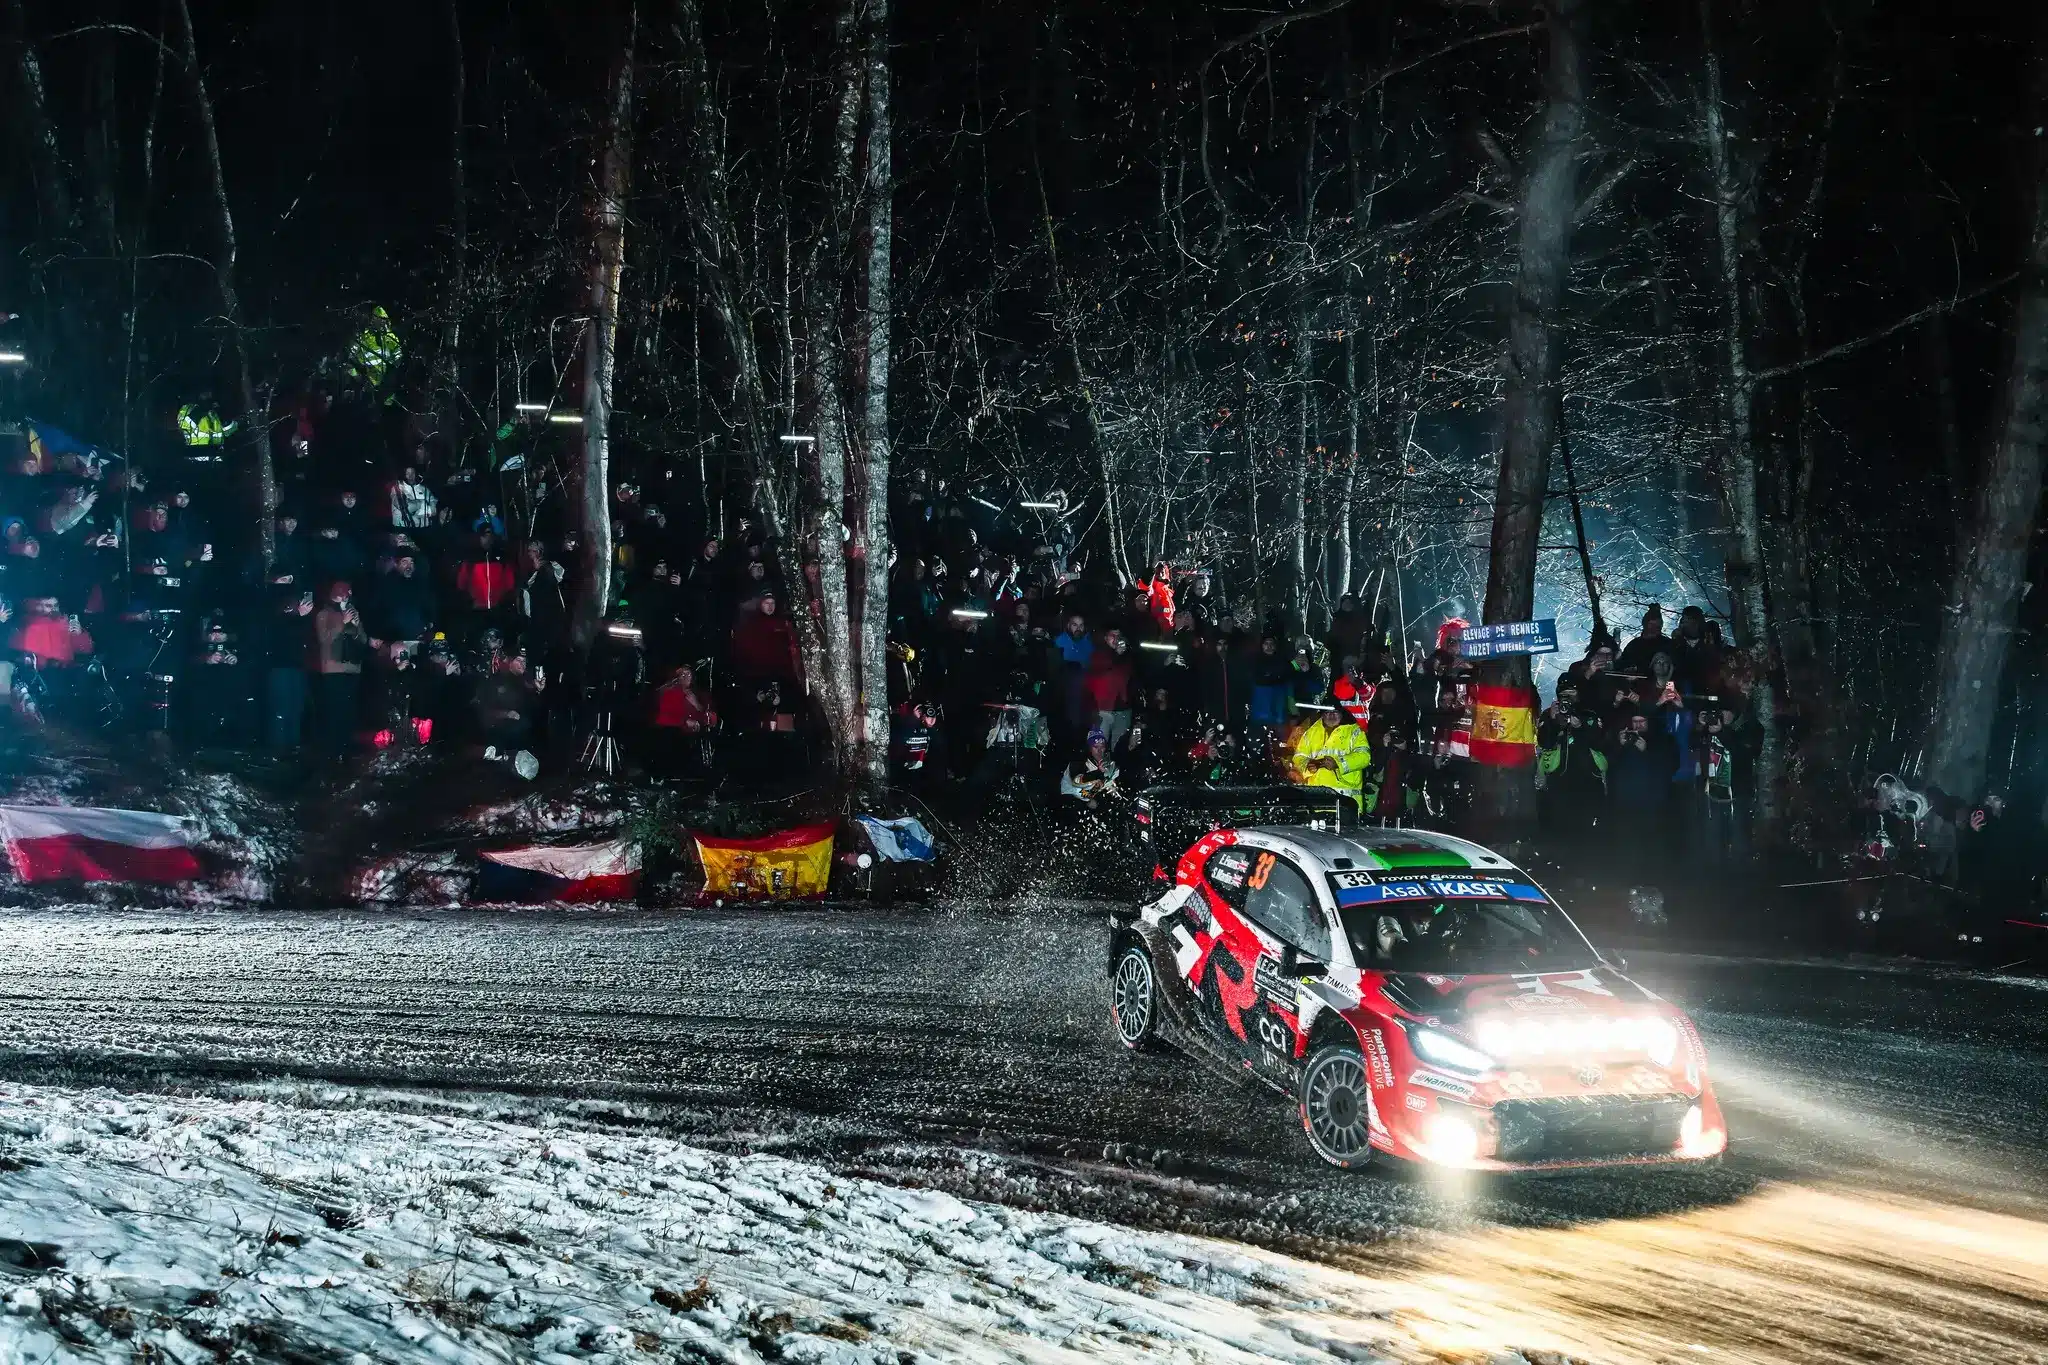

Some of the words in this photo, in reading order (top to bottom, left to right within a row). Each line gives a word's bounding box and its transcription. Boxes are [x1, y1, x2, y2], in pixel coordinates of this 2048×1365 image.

[1463, 627, 1490, 641] ELEVAGE
[1496, 625, 1505, 637] DE
[1511, 623, 1540, 636] RENNES
[1469, 643, 1490, 656] AUZET
[1248, 852, 1276, 890] 33
[1379, 873, 1428, 882] TOYOTA
[1430, 873, 1474, 881] GAZOO
[1347, 872, 1370, 887] 33
[1360, 1028, 1385, 1090] AUTOMOTIVE
[1371, 1028, 1395, 1088] Panasonic
[1405, 1096, 1428, 1110] OMP
